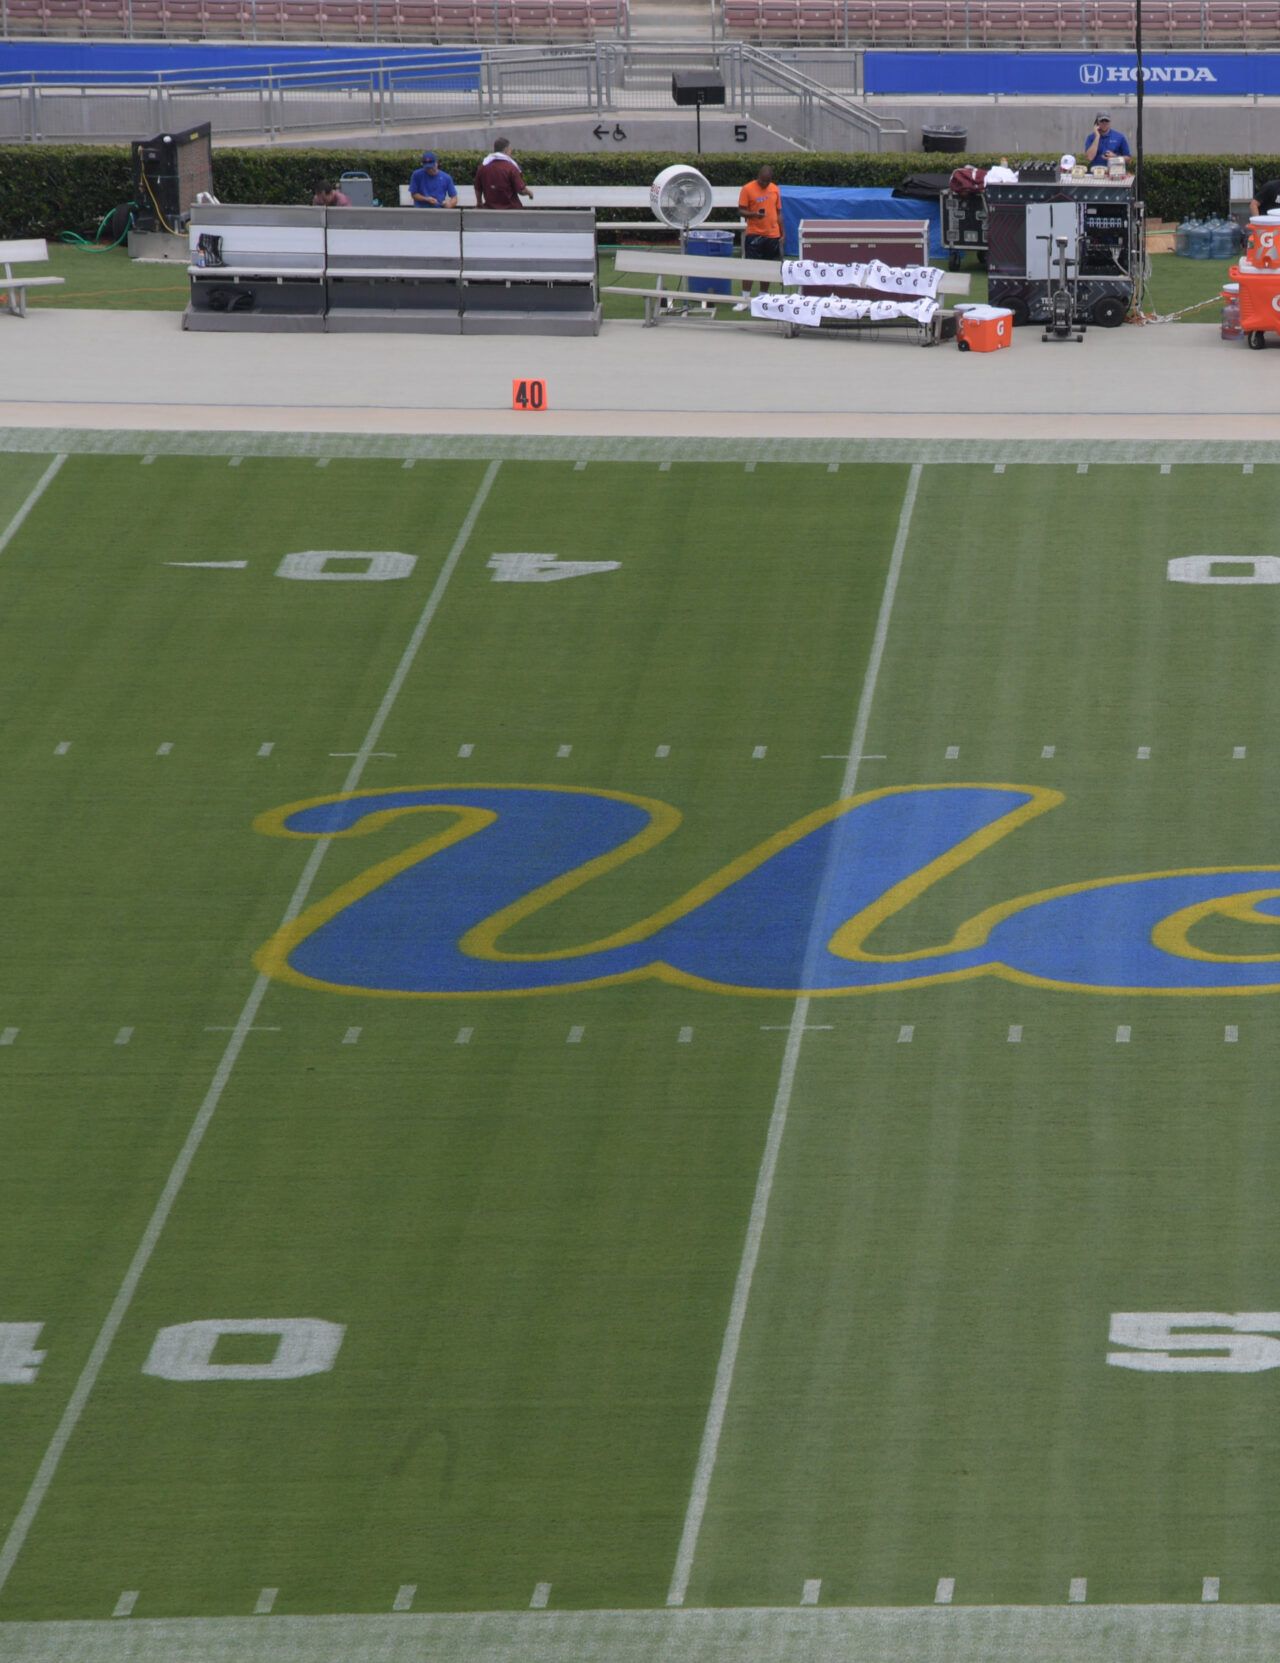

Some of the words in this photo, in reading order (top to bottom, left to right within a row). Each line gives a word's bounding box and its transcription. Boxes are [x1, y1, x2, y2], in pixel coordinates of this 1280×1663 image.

[1106, 67, 1217, 82] HONDA
[734, 125, 747, 142] 5
[1260, 231, 1274, 248] G
[515, 381, 543, 409] 40
